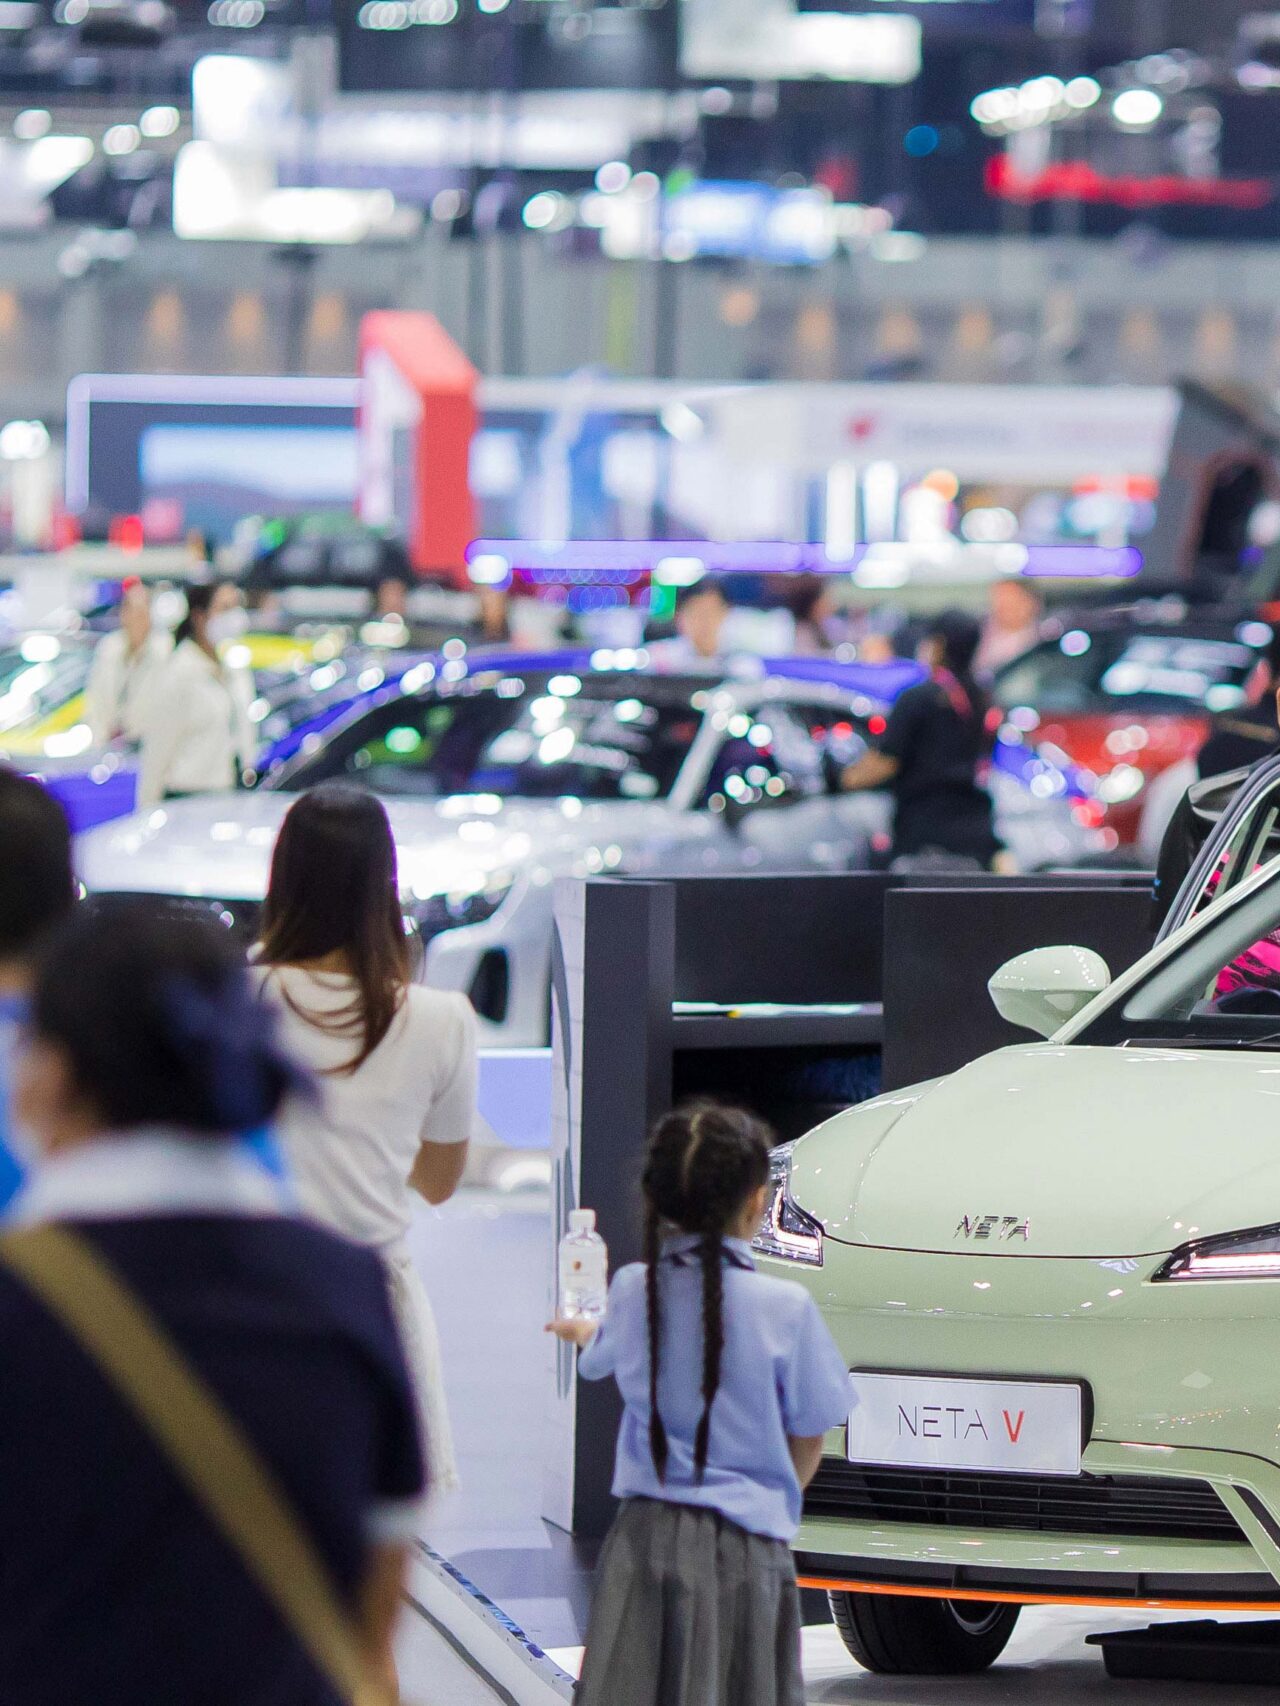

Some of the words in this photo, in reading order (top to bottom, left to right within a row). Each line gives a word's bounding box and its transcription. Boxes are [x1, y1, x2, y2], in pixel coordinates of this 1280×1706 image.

[953, 1214, 1031, 1242] NETA
[898, 1404, 989, 1441] NETA
[1002, 1409, 1025, 1443] V
